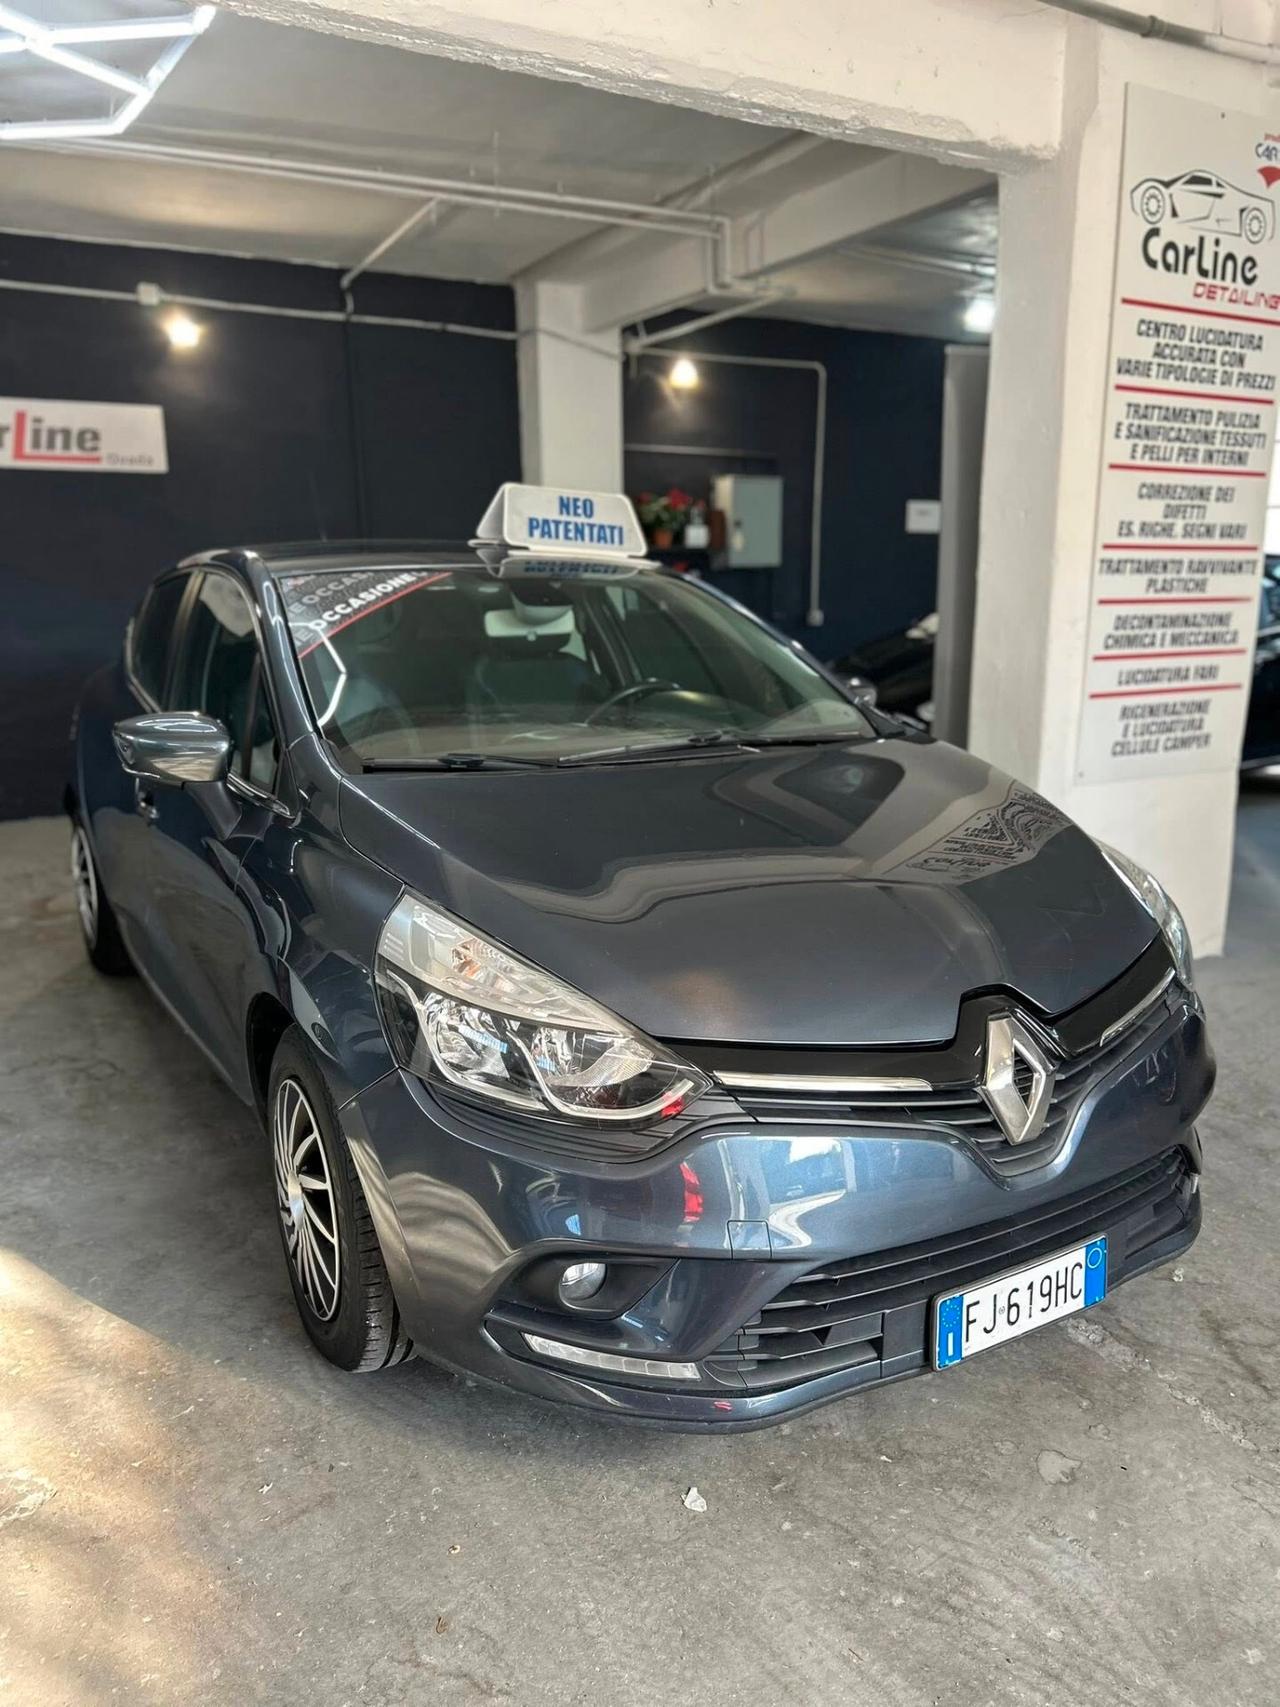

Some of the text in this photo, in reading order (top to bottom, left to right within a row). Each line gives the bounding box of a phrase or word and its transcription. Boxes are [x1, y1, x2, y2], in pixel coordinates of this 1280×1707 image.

[1142, 227, 1258, 286] CarLine
[1192, 281, 1280, 310] DETAILING
[1136, 318, 1263, 351] CENTRO LUCIDATURA
[1152, 342, 1247, 369] ACCURATA CON
[1116, 358, 1276, 391] VARIE TIPOLOGIE DI PREZZI
[1125, 402, 1261, 429] TRATTAMENTO PULIZIA
[1115, 422, 1266, 449] E SANIFICAZIONE TESSUTI
[1131, 443, 1249, 466] E PELLI PER INTERNI
[1137, 482, 1235, 503] CORREZIONE DEI
[558, 495, 594, 518] NEO
[1162, 503, 1207, 520] DIFETTI
[528, 517, 624, 545] PATENTATI
[1118, 521, 1136, 537] ES.
[1182, 523, 1217, 540] SEGNI
[1219, 524, 1247, 539] VARI
[1099, 558, 1183, 576] TRATTAMENTO
[1145, 577, 1208, 594] PLASTICHE
[308, 572, 416, 630] OCCASIONE
[1113, 612, 1232, 631] DECONTAMINAZIONE
[1104, 630, 1238, 650] CHIMICA E MECCANICA
[1117, 665, 1219, 687] LUCIDATURA FARI
[1119, 699, 1212, 721] RIGENERAZIONE
[1122, 718, 1204, 738] E LUCIDATURA
[1111, 734, 1211, 757] CELLULE CAMPER
[965, 1261, 1083, 1343] FJ619HC
